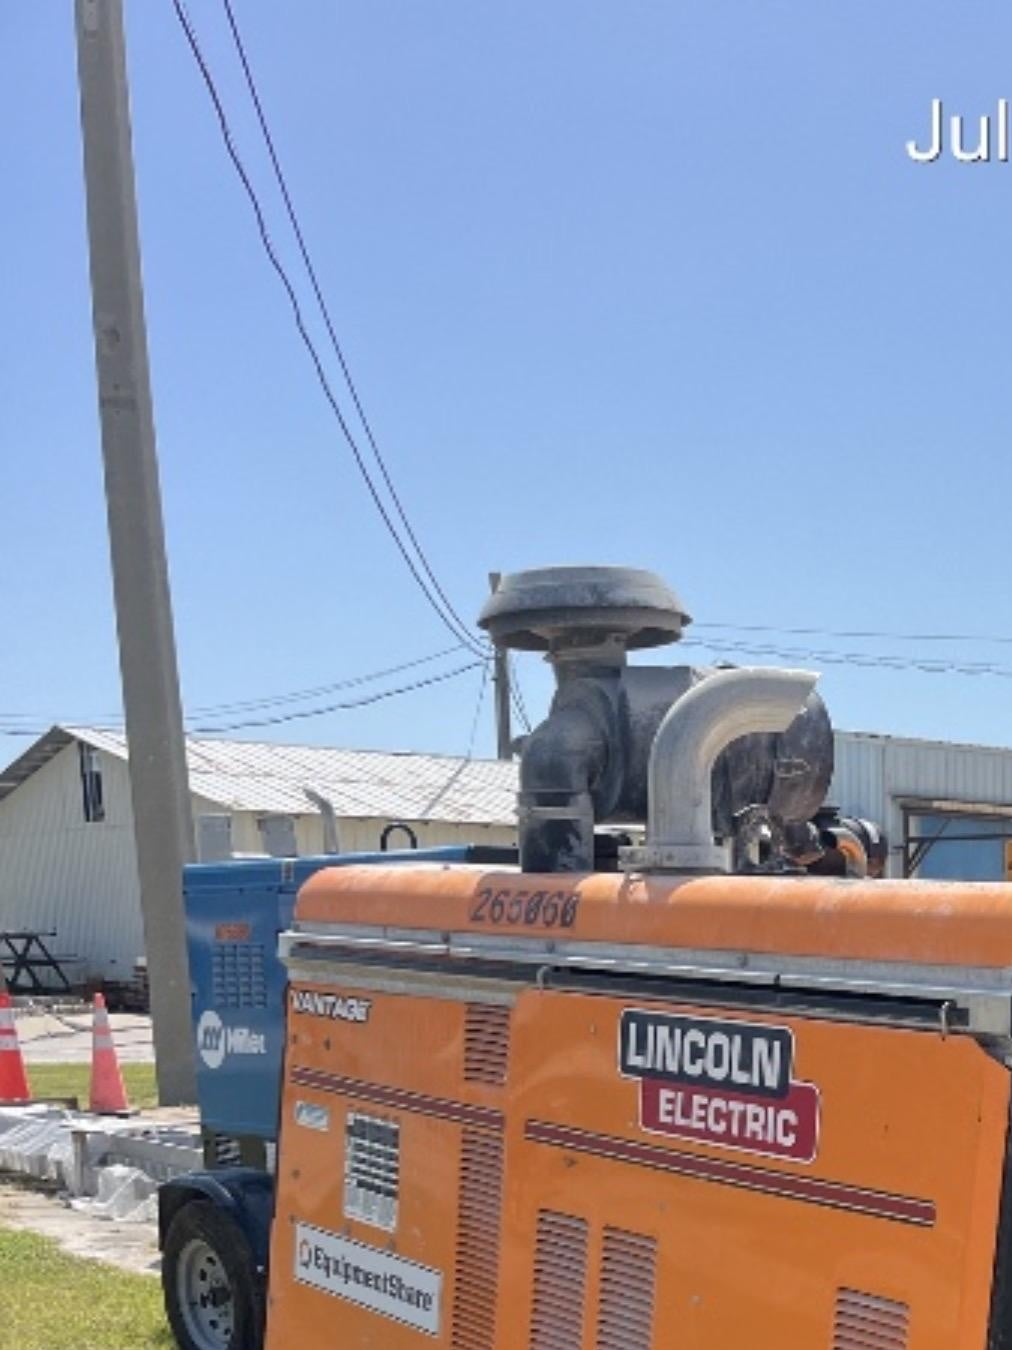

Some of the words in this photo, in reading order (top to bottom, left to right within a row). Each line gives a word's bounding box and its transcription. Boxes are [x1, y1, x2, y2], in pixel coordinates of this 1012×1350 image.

[290, 991, 372, 1022] VANTAGE
[626, 1021, 782, 1089] LINCOLN
[659, 1088, 799, 1147] ELECTRIC
[313, 1244, 434, 1312] EquipmentShare
